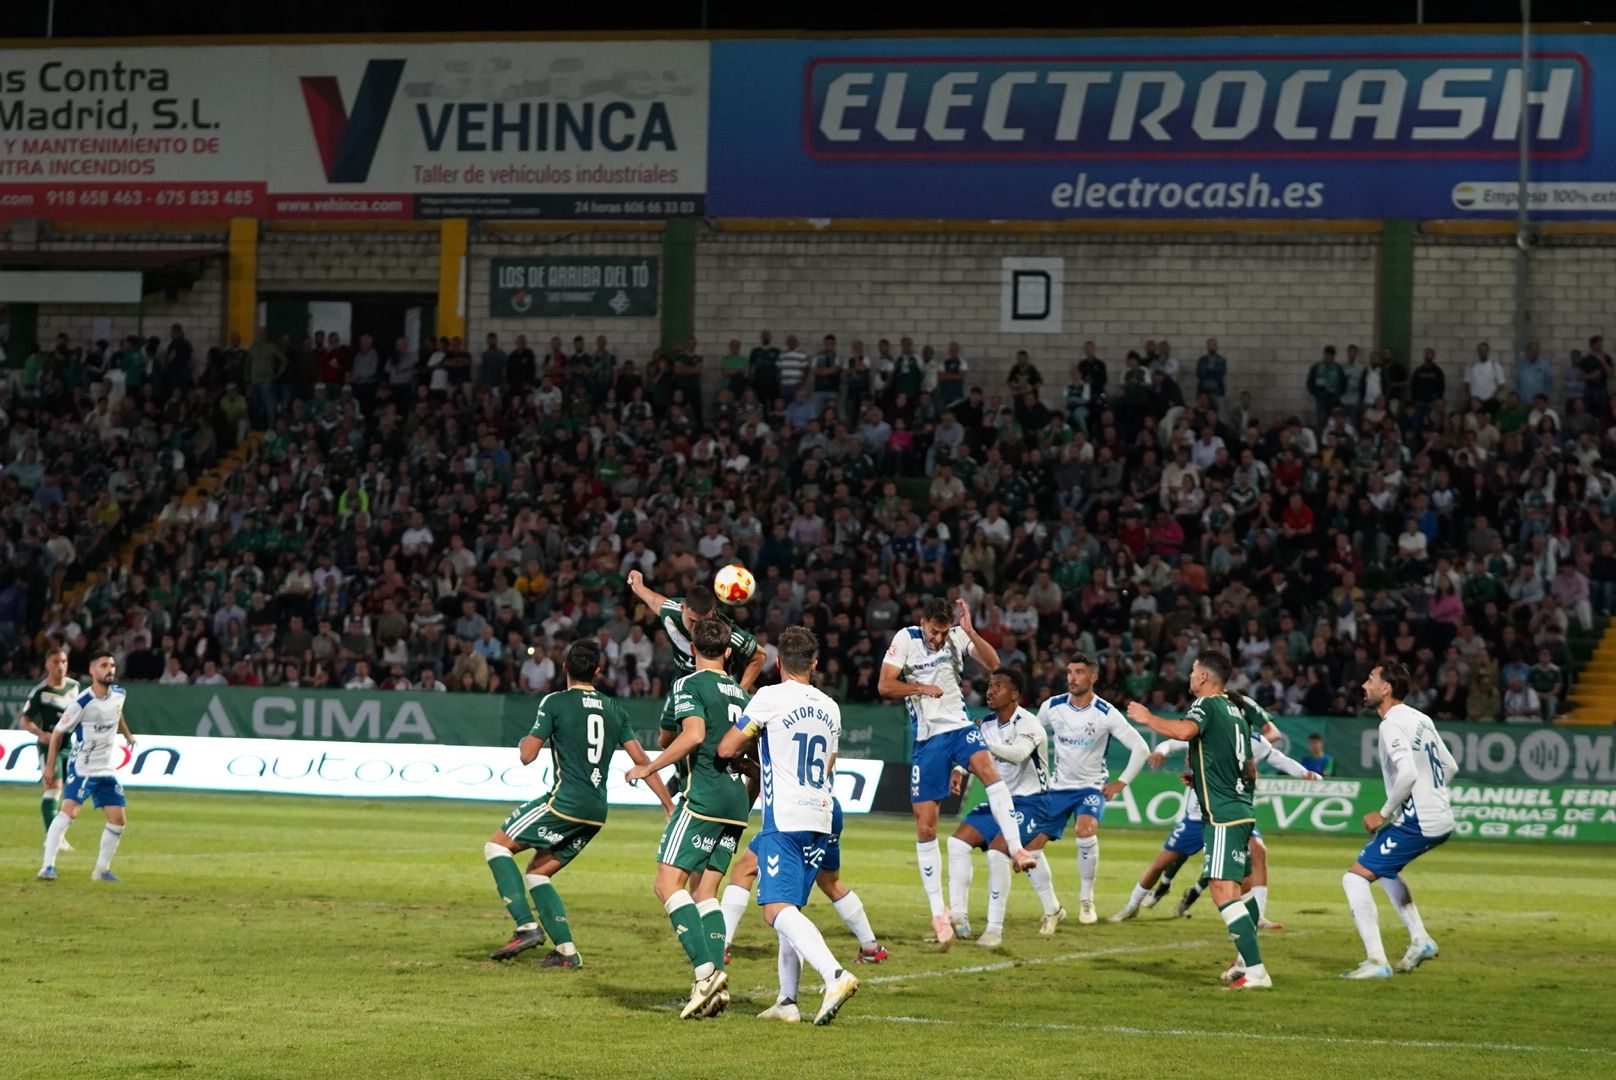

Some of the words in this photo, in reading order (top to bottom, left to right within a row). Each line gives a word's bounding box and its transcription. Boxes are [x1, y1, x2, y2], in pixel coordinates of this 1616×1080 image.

[0, 70, 26, 94] s
[39, 59, 170, 93] Contra
[0, 98, 139, 134] Madrid,
[153, 98, 220, 130] S.L.
[818, 68, 1576, 142] ELECTROCASH
[416, 101, 678, 152] VEHINCA
[5, 138, 17, 153] Y
[22, 137, 188, 154] MANTENIMIENTO
[191, 137, 220, 153] DE
[49, 159, 156, 176] INCENDIOS
[413, 164, 458, 184] Taller
[464, 164, 484, 184] de
[490, 164, 571, 184] vehículos
[576, 163, 679, 184] industriales
[156, 190, 185, 206] 675
[1050, 172, 1325, 209] electrocash.es
[1483, 188, 1548, 206] Empsa
[498, 266, 525, 288] LOS
[528, 266, 546, 288] DE
[548, 266, 601, 288] ARRIBA
[604, 265, 629, 288] DEL
[1012, 270, 1051, 320] D
[252, 695, 436, 741] CIMA
[782, 705, 815, 730] AITOR
[587, 713, 605, 765] 9
[792, 732, 827, 791] 16
[1361, 730, 1516, 772] RDIO
[1573, 733, 1616, 785] M
[1446, 785, 1553, 807] MANUEL
[1560, 789, 1616, 807] FER
[1450, 806, 1558, 822] EFORMAS
[1564, 811, 1596, 823] DE
[1479, 823, 1509, 837] 63
[1515, 825, 1548, 838] 42
[1553, 826, 1578, 839] 41
